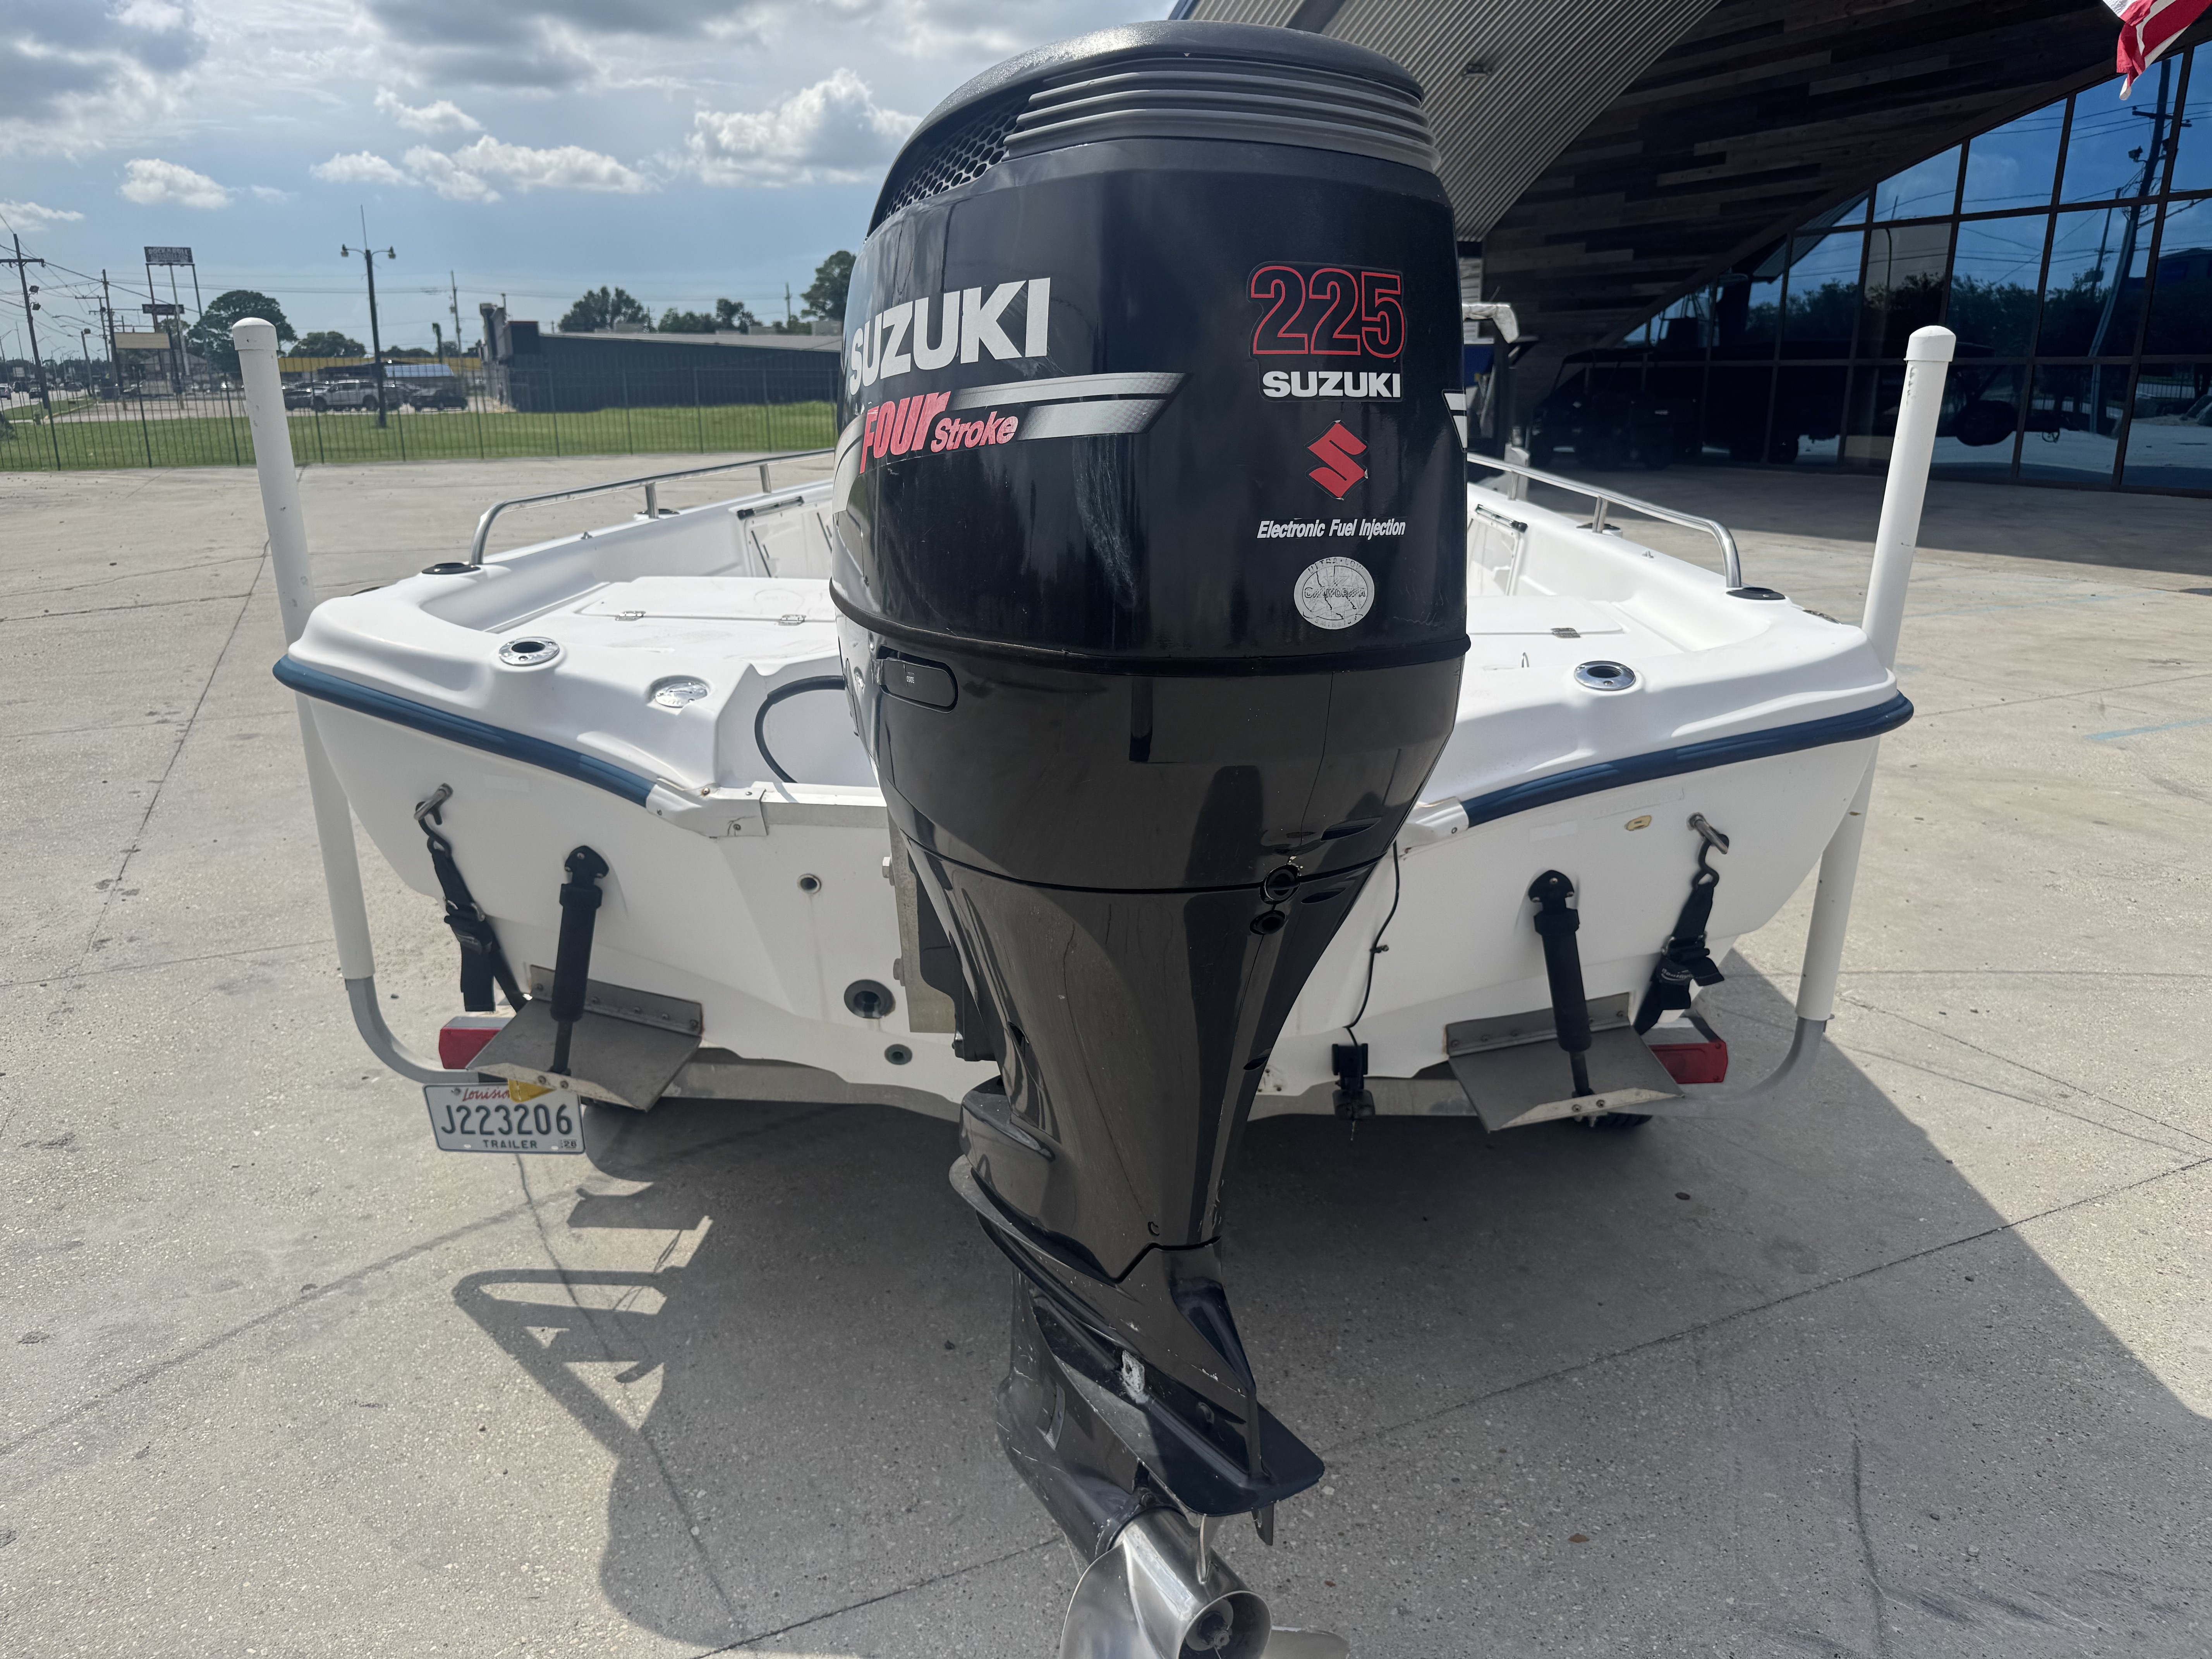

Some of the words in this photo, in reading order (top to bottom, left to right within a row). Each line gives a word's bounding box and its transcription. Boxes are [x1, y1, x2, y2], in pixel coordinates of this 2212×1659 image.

[1251, 266, 1405, 359] 225
[850, 277, 1051, 395] SUZUKI
[1262, 371, 1401, 398] SUZUKI
[931, 411, 1018, 453] Stroke
[1257, 519, 1325, 539] Electronic
[1328, 519, 1358, 537] Fuel
[1358, 518, 1406, 540] Injection
[441, 1104, 573, 1135] J223206
[483, 1140, 537, 1149] TRAILER
